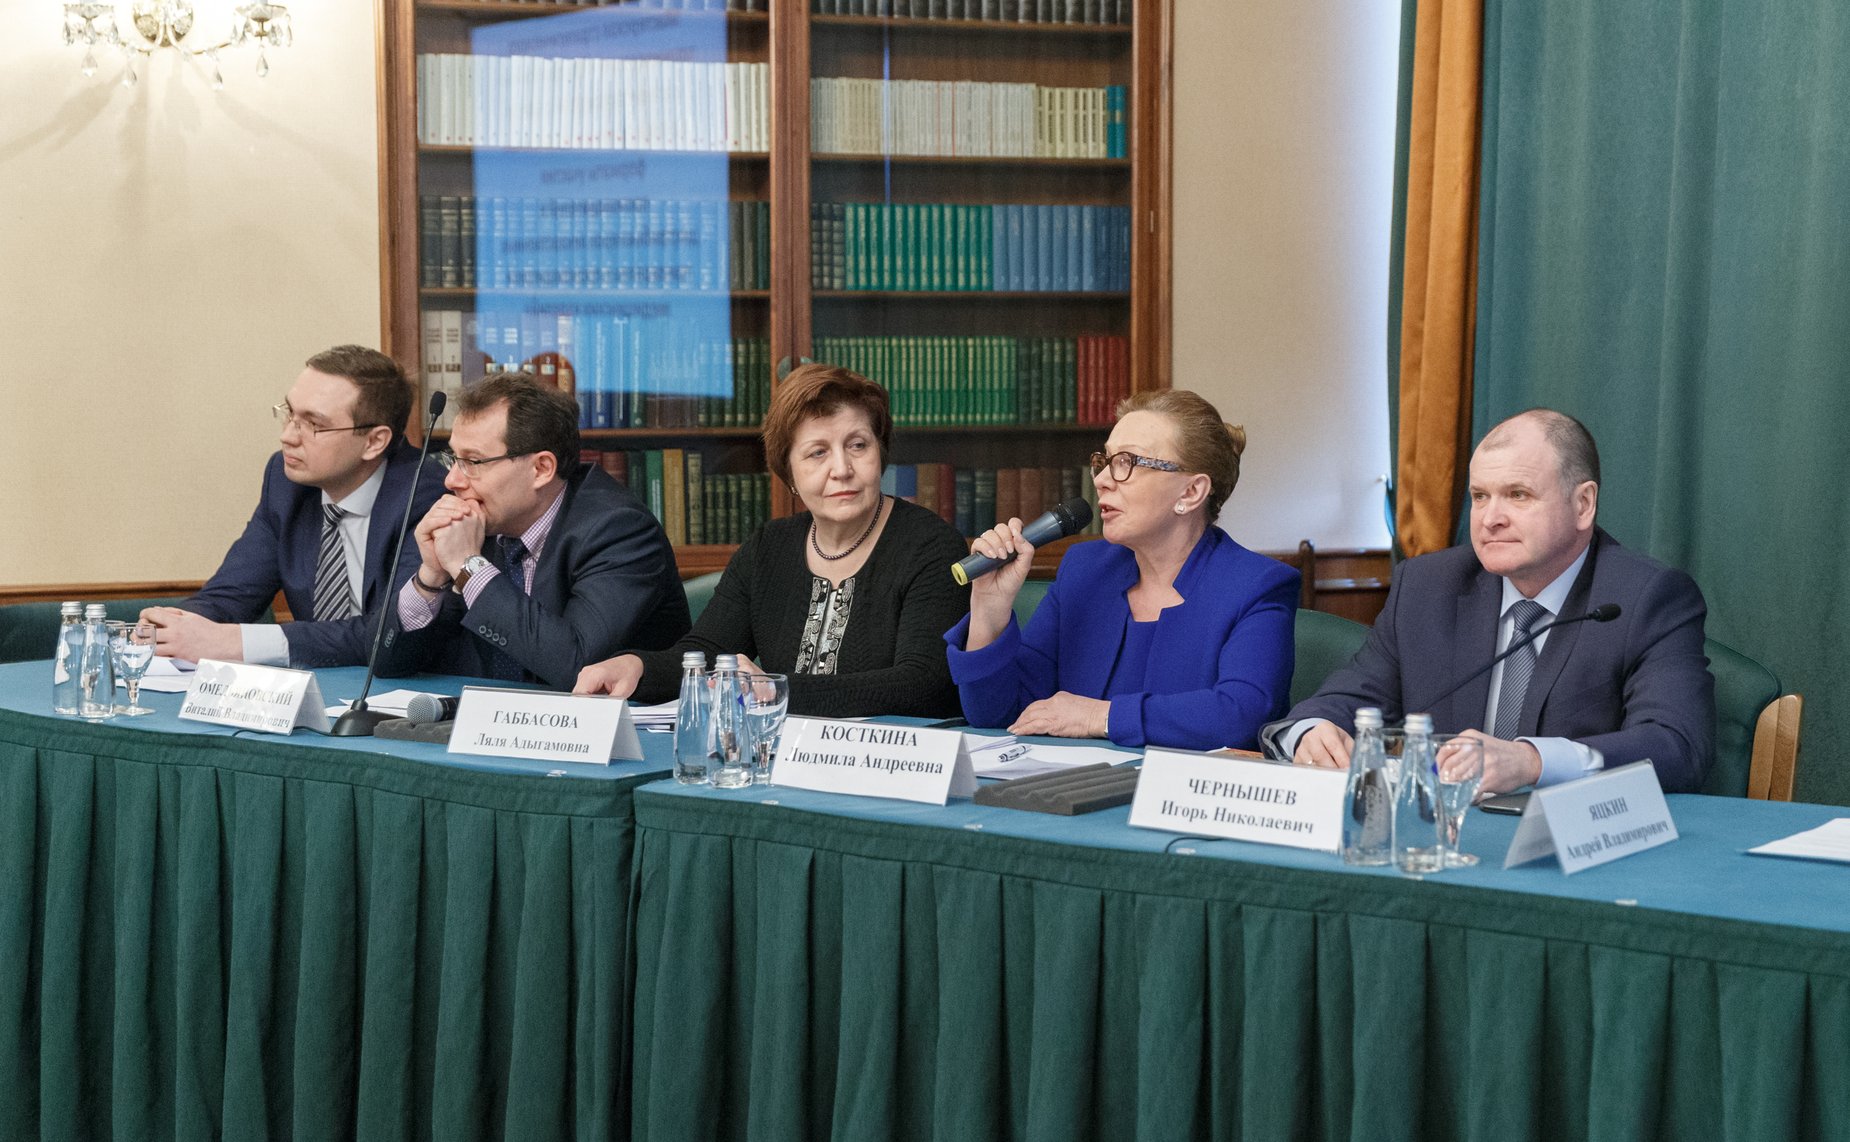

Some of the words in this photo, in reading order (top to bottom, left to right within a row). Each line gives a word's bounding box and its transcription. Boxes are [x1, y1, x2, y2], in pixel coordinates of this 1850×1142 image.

[493, 710, 578, 729] ГАББАСОВА
[474, 733, 507, 747] Ляля
[510, 736, 590, 754] Адыгамовна
[820, 725, 917, 747] КОСТКИНА
[785, 747, 855, 768] Людмила
[860, 753, 943, 775] Андреевна
[1188, 778, 1297, 806] ЧЕРНЫШЕВ
[1161, 800, 1208, 822] Игорь
[1213, 807, 1314, 834] Николаевич
[1588, 797, 1629, 821] ЯЦКИН
[1566, 836, 1603, 859] Андрей
[1601, 820, 1669, 849] Владимирович
